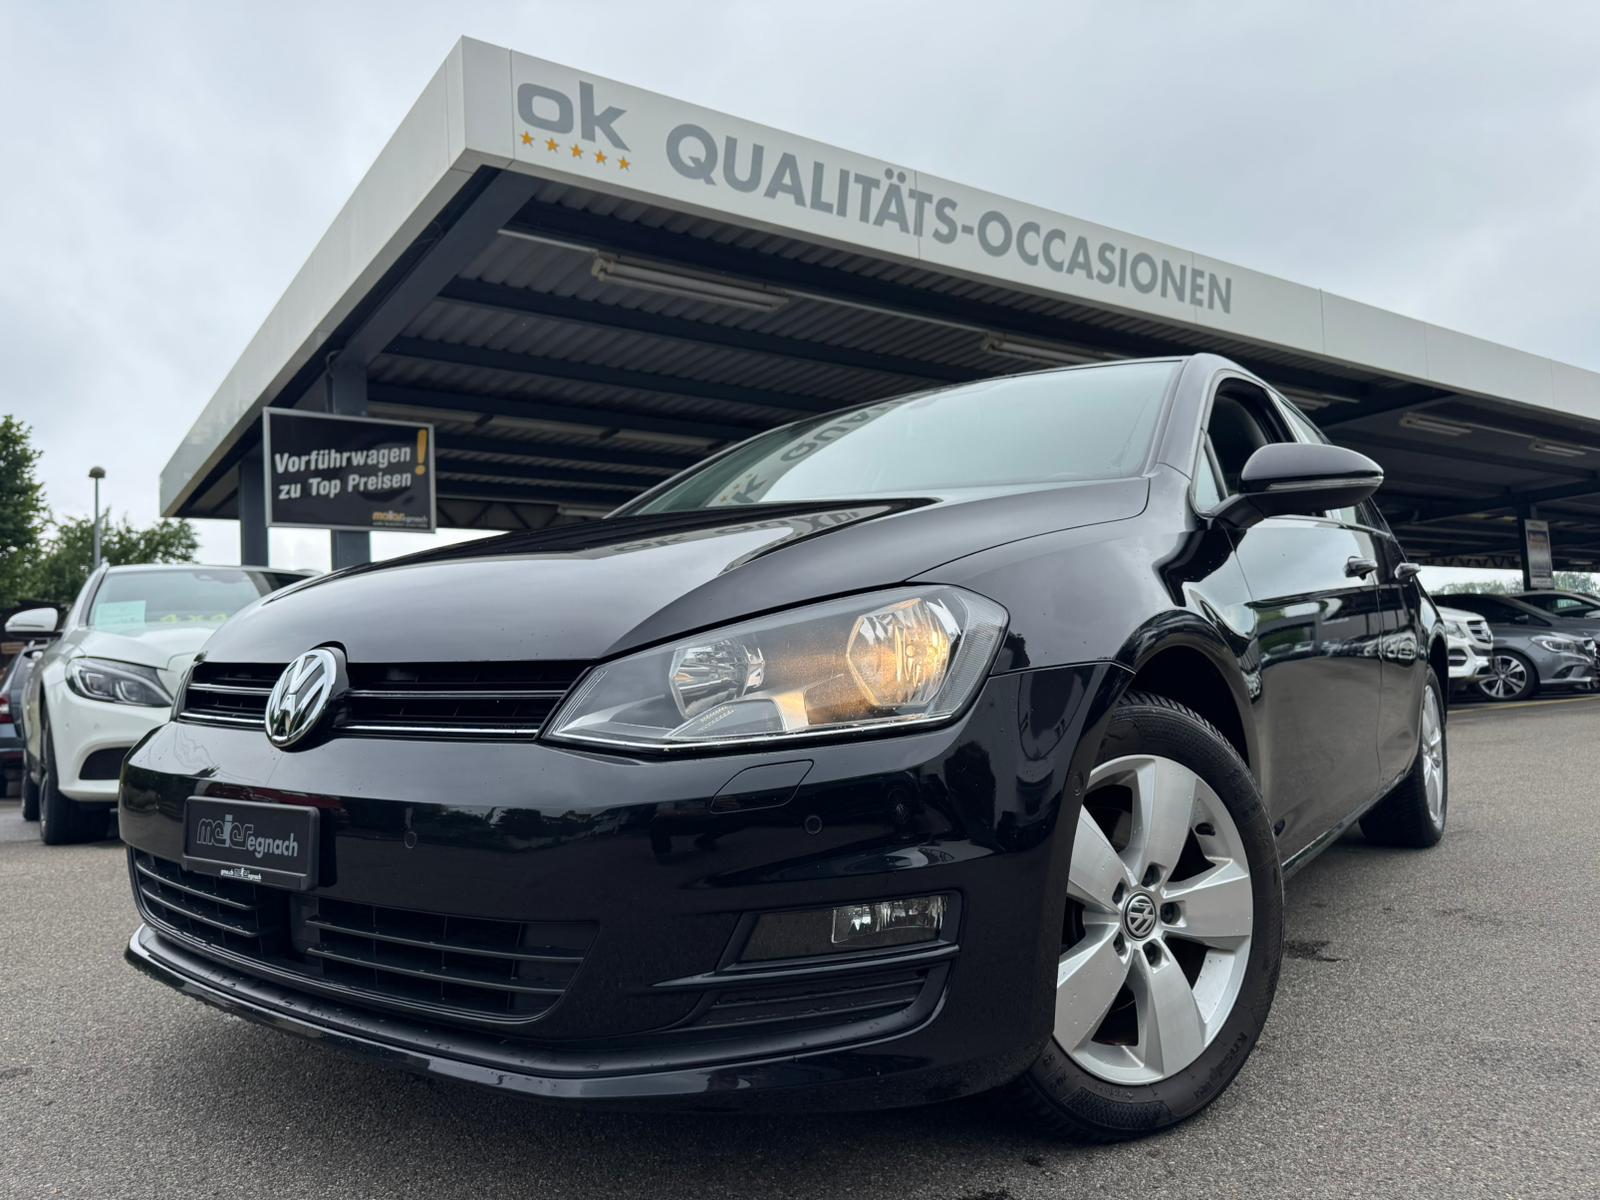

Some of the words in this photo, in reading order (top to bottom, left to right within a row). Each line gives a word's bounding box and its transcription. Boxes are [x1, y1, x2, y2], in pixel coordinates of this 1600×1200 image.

[517, 80, 631, 152] ok
[666, 123, 1232, 314] QUALITÄTS-OCCASIONEN
[274, 446, 411, 474] Vorführwagen
[278, 483, 302, 499] zu
[308, 477, 341, 498] Top
[347, 472, 412, 492] Preisen
[247, 833, 298, 858] egnach
